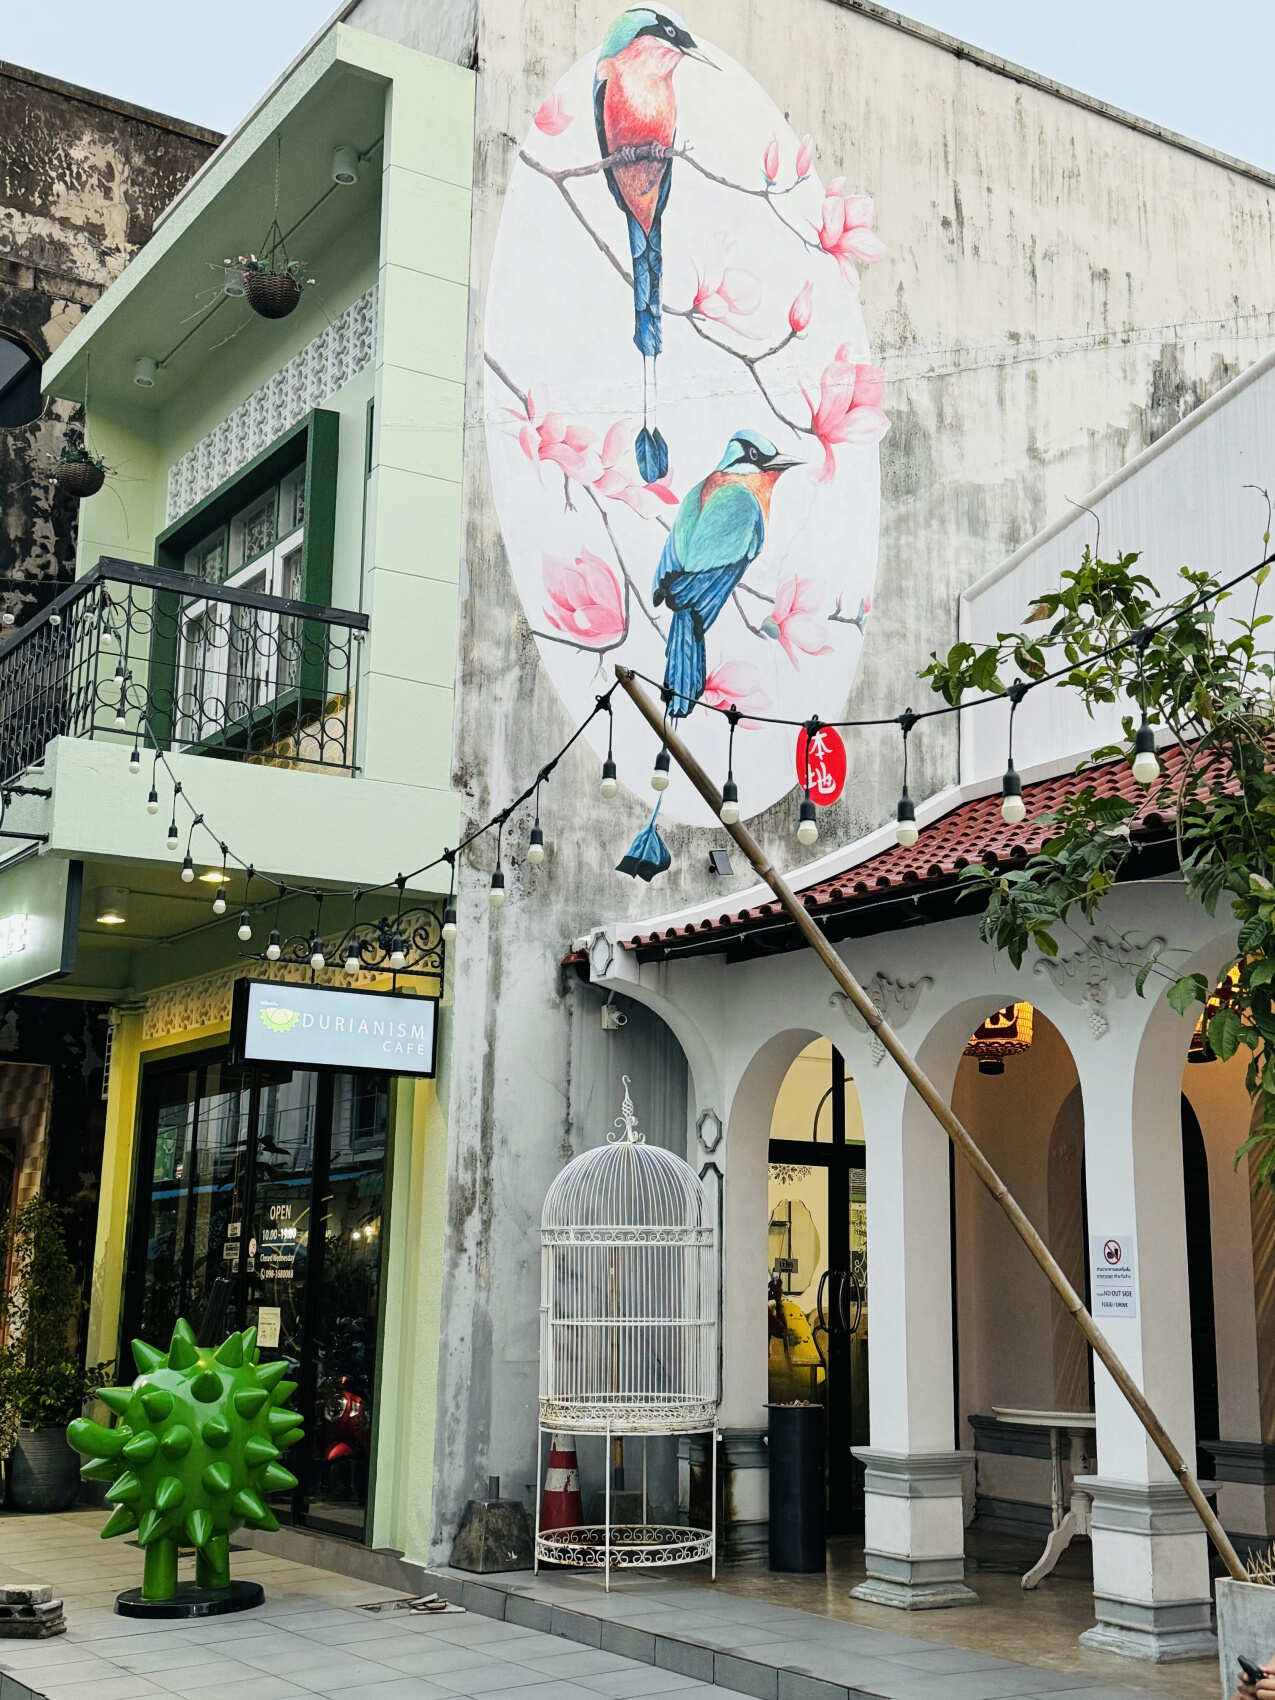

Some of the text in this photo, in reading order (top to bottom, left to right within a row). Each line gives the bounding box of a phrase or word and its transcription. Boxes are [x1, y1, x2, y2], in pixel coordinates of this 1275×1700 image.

[803, 731, 837, 794] 本地
[301, 1012, 425, 1040] DURIANISM
[382, 1040, 425, 1056] CAFE
[269, 1204, 292, 1220] OPEN
